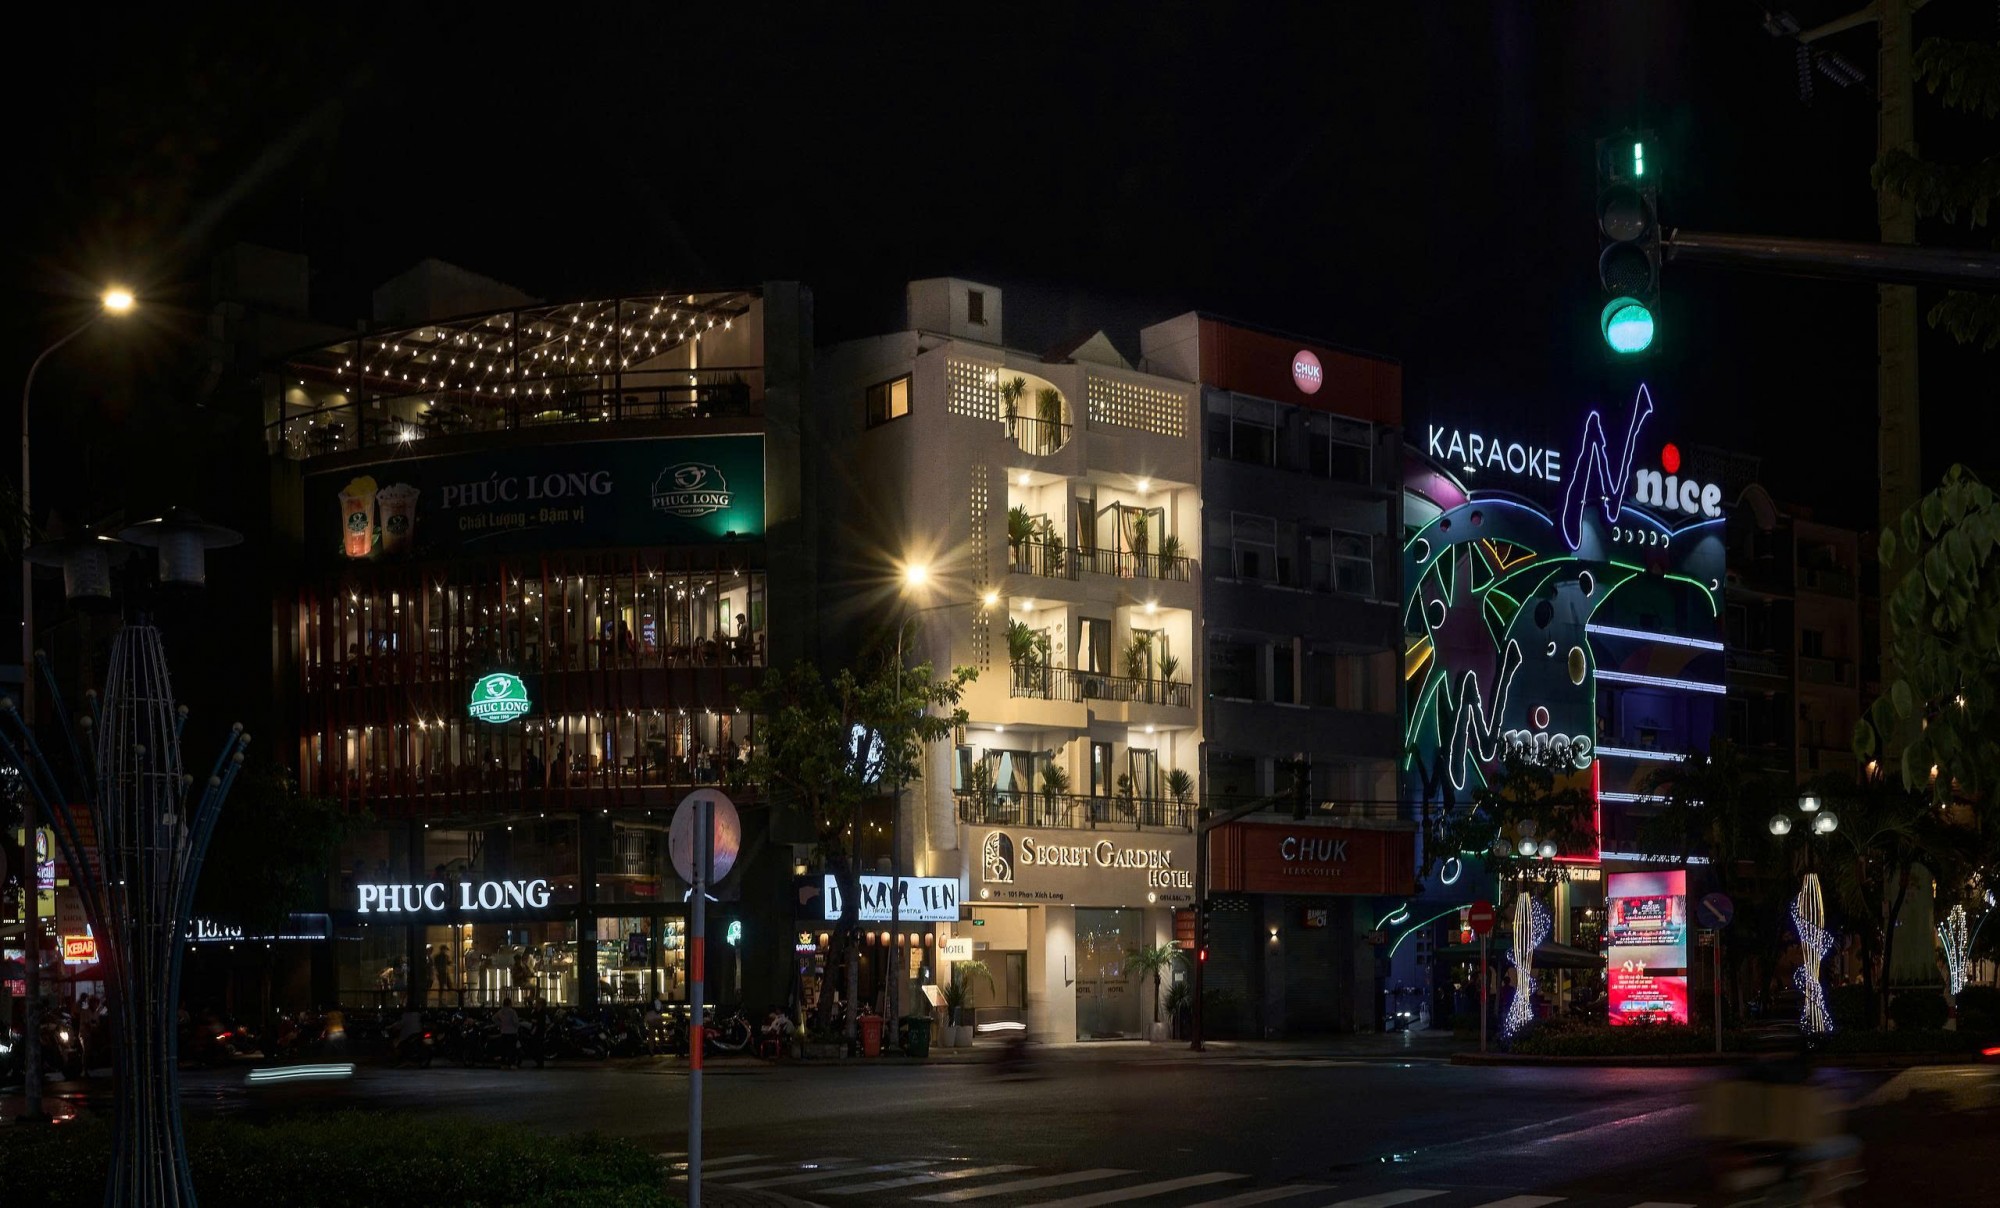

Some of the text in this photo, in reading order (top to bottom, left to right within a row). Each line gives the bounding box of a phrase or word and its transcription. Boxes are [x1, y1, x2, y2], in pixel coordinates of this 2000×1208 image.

[1295, 361, 1320, 377] CHUK
[1428, 424, 1561, 482] KARAOKE
[440, 470, 614, 509] PHÚC LONG
[1635, 442, 1722, 518] nice
[652, 493, 729, 508] PHUC LONG
[458, 511, 487, 532] Chất
[573, 505, 585, 524] vị
[470, 702, 529, 716] PHUC LONG
[1281, 836, 1348, 862] CHUK
[1148, 870, 1193, 888] HOTEL
[357, 879, 551, 913] PHUC LONG
[919, 883, 955, 912] TEN
[66, 941, 94, 956] KEBAB
[943, 945, 965, 954] HOTEL
